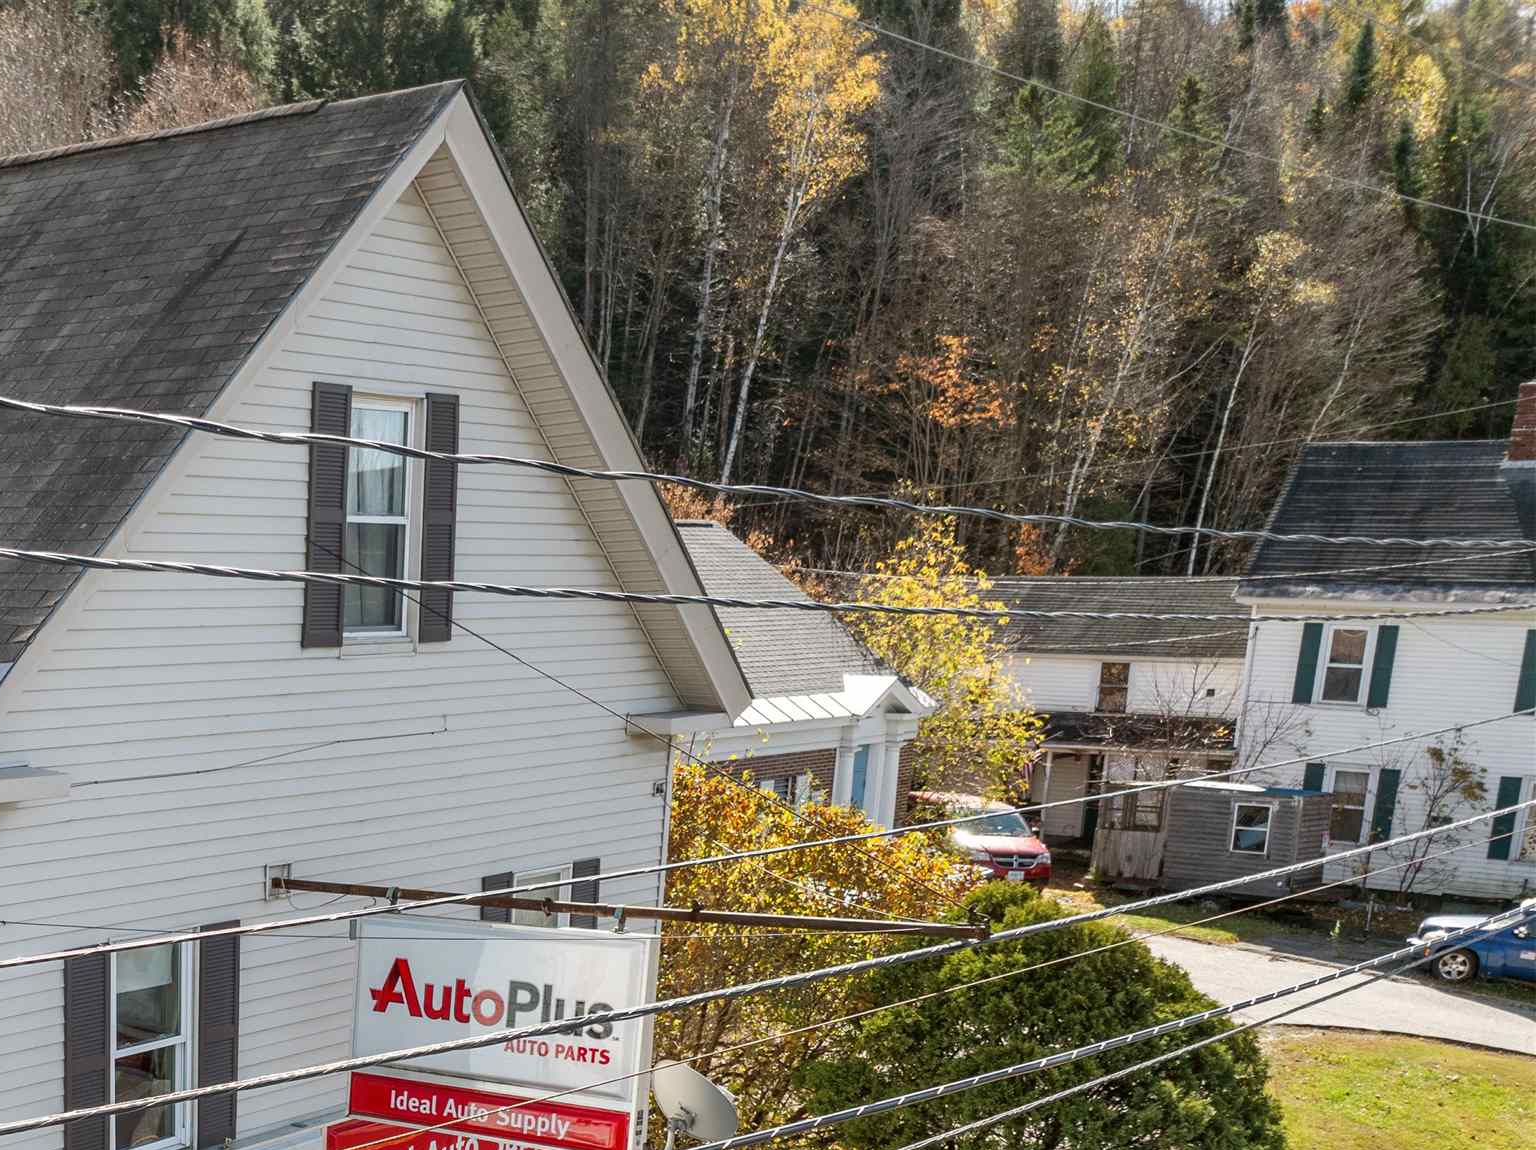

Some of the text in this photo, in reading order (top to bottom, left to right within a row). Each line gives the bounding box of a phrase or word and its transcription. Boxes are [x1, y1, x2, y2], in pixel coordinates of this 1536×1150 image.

[369, 957, 614, 1040] AutoPlus
[504, 1039, 610, 1065] AUTO PARTS
[390, 1089, 571, 1140] Ideal Auto Supply
